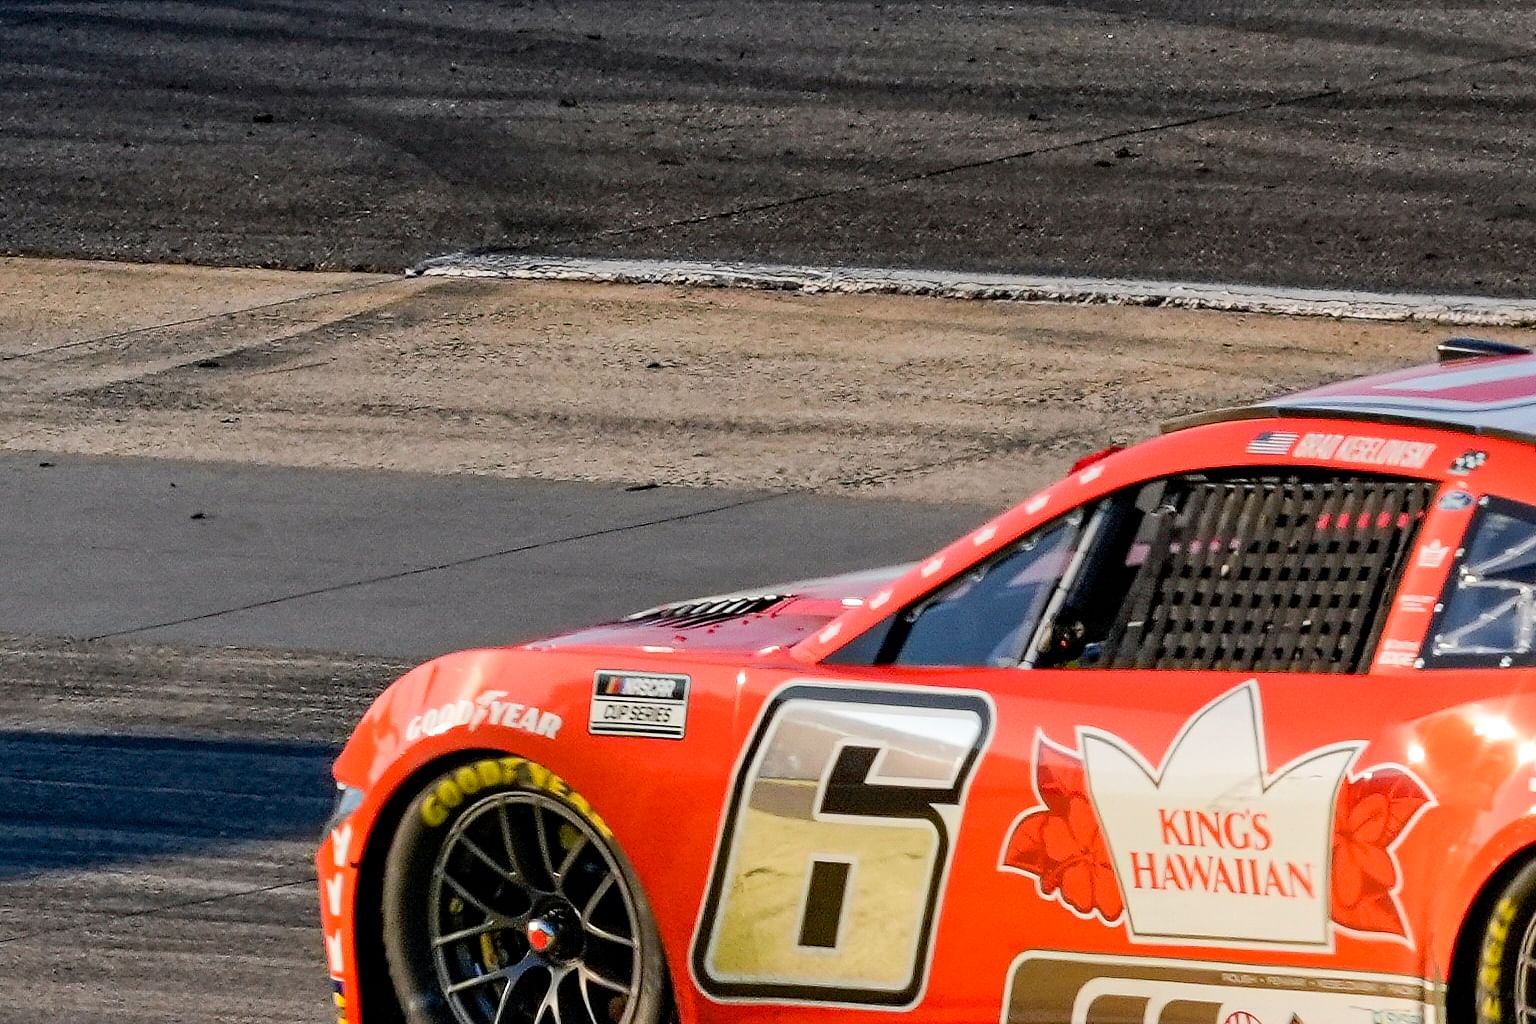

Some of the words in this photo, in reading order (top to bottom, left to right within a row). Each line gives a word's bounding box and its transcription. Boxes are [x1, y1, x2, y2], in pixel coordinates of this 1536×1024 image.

[404, 690, 563, 741] GOODYEAR
[603, 704, 628, 722] CUP
[629, 705, 673, 723] SERIES
[689, 680, 996, 1011] 6
[1158, 808, 1274, 852] KING'S
[1129, 850, 1318, 899] HAWAIIAN
